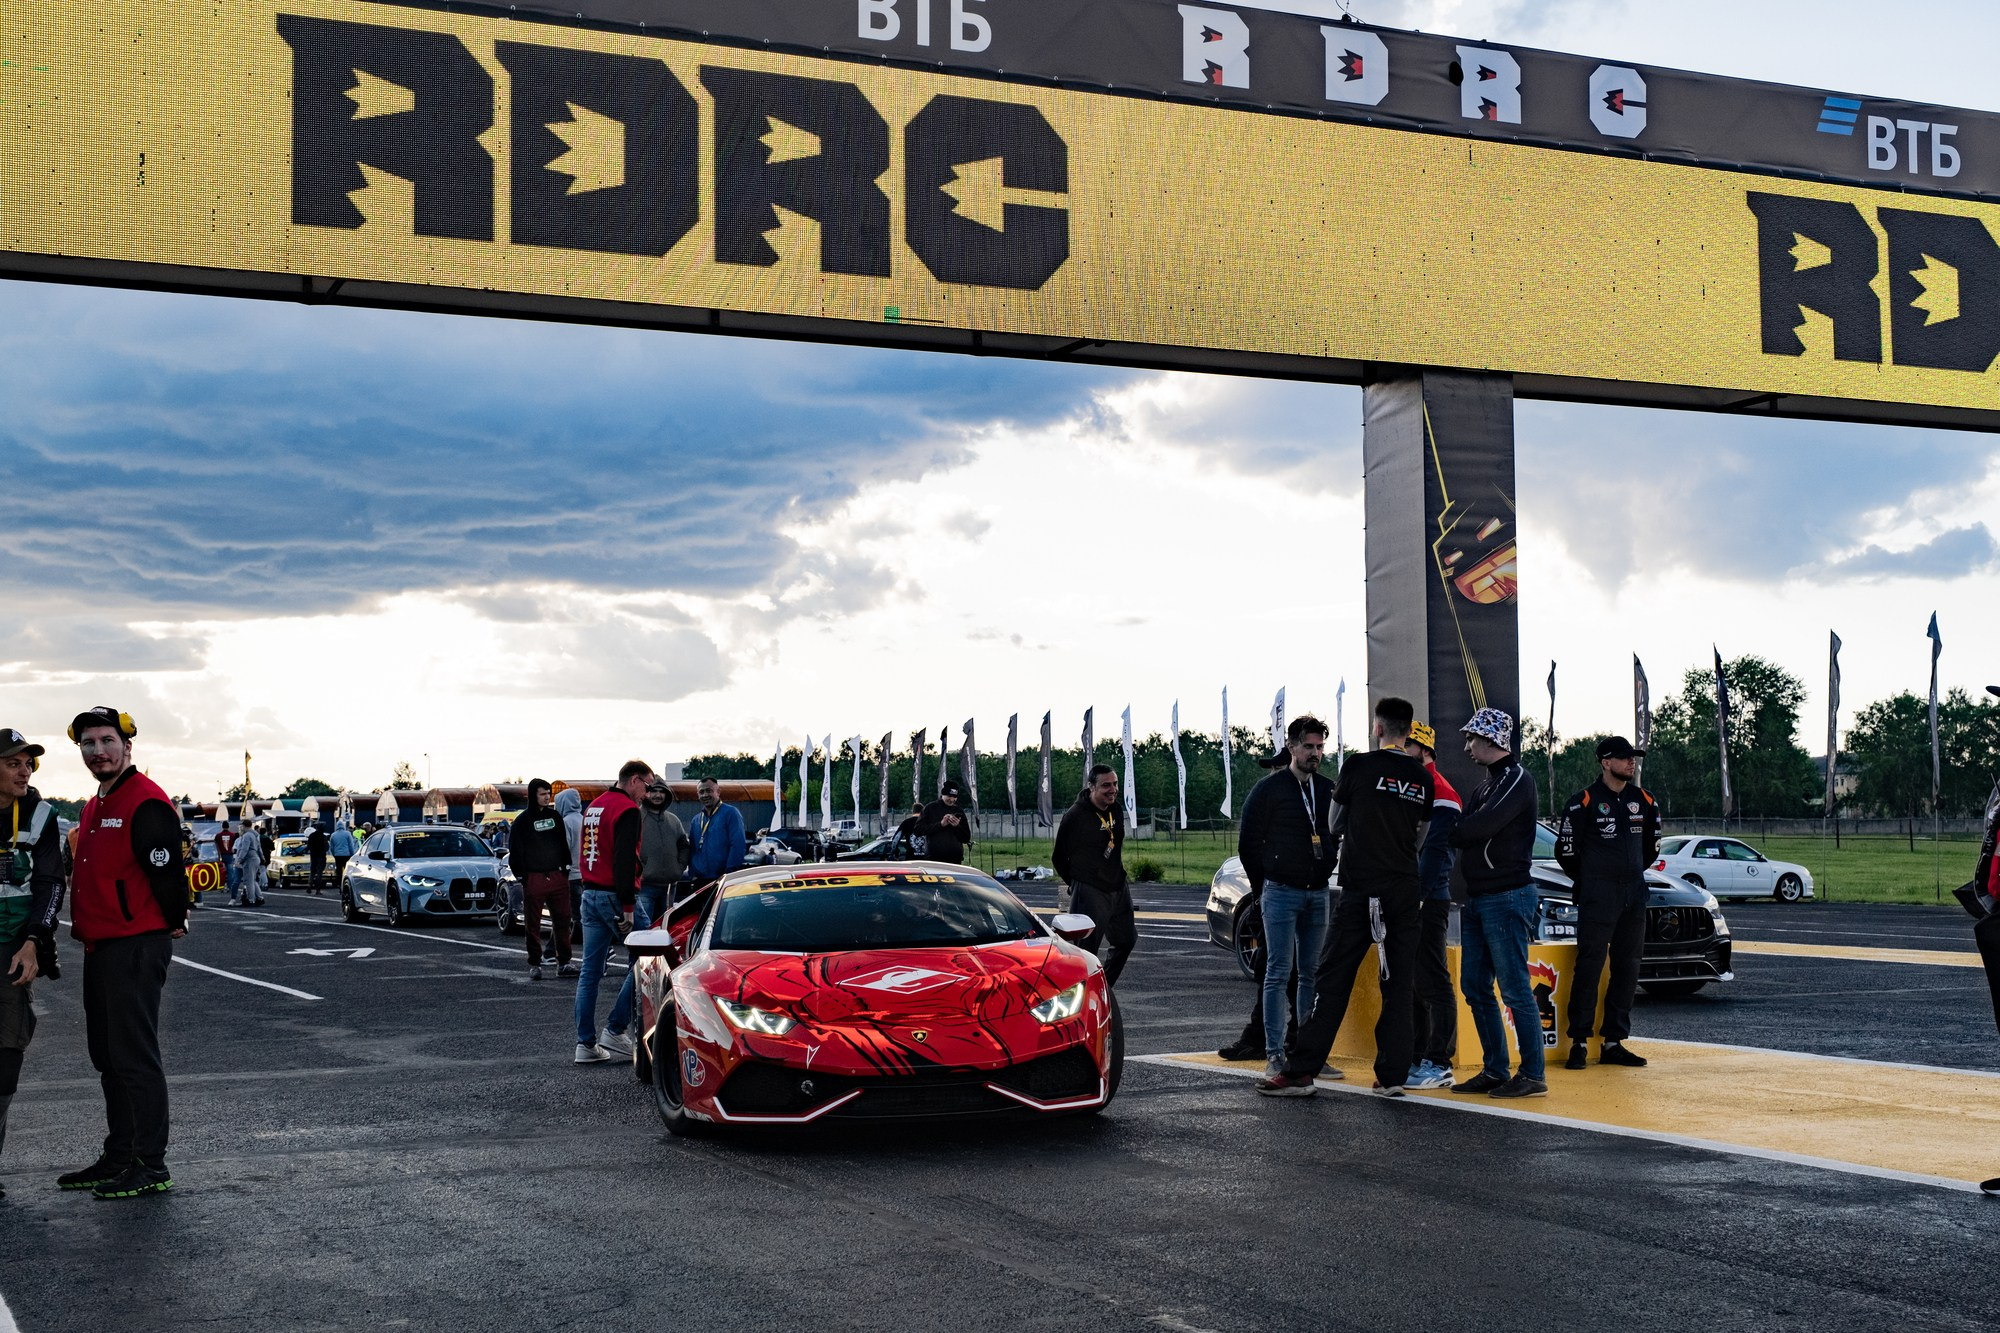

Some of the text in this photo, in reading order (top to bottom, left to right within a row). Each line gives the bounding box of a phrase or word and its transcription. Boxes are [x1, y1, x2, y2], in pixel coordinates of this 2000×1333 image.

[277, 13, 1069, 290] RDRC
[1867, 115, 1961, 177] ВТБ
[1376, 777, 1425, 800] LEVEL
[759, 877, 849, 891] RDRC
[904, 875, 955, 883] 503
[1544, 925, 1577, 935] RDR
